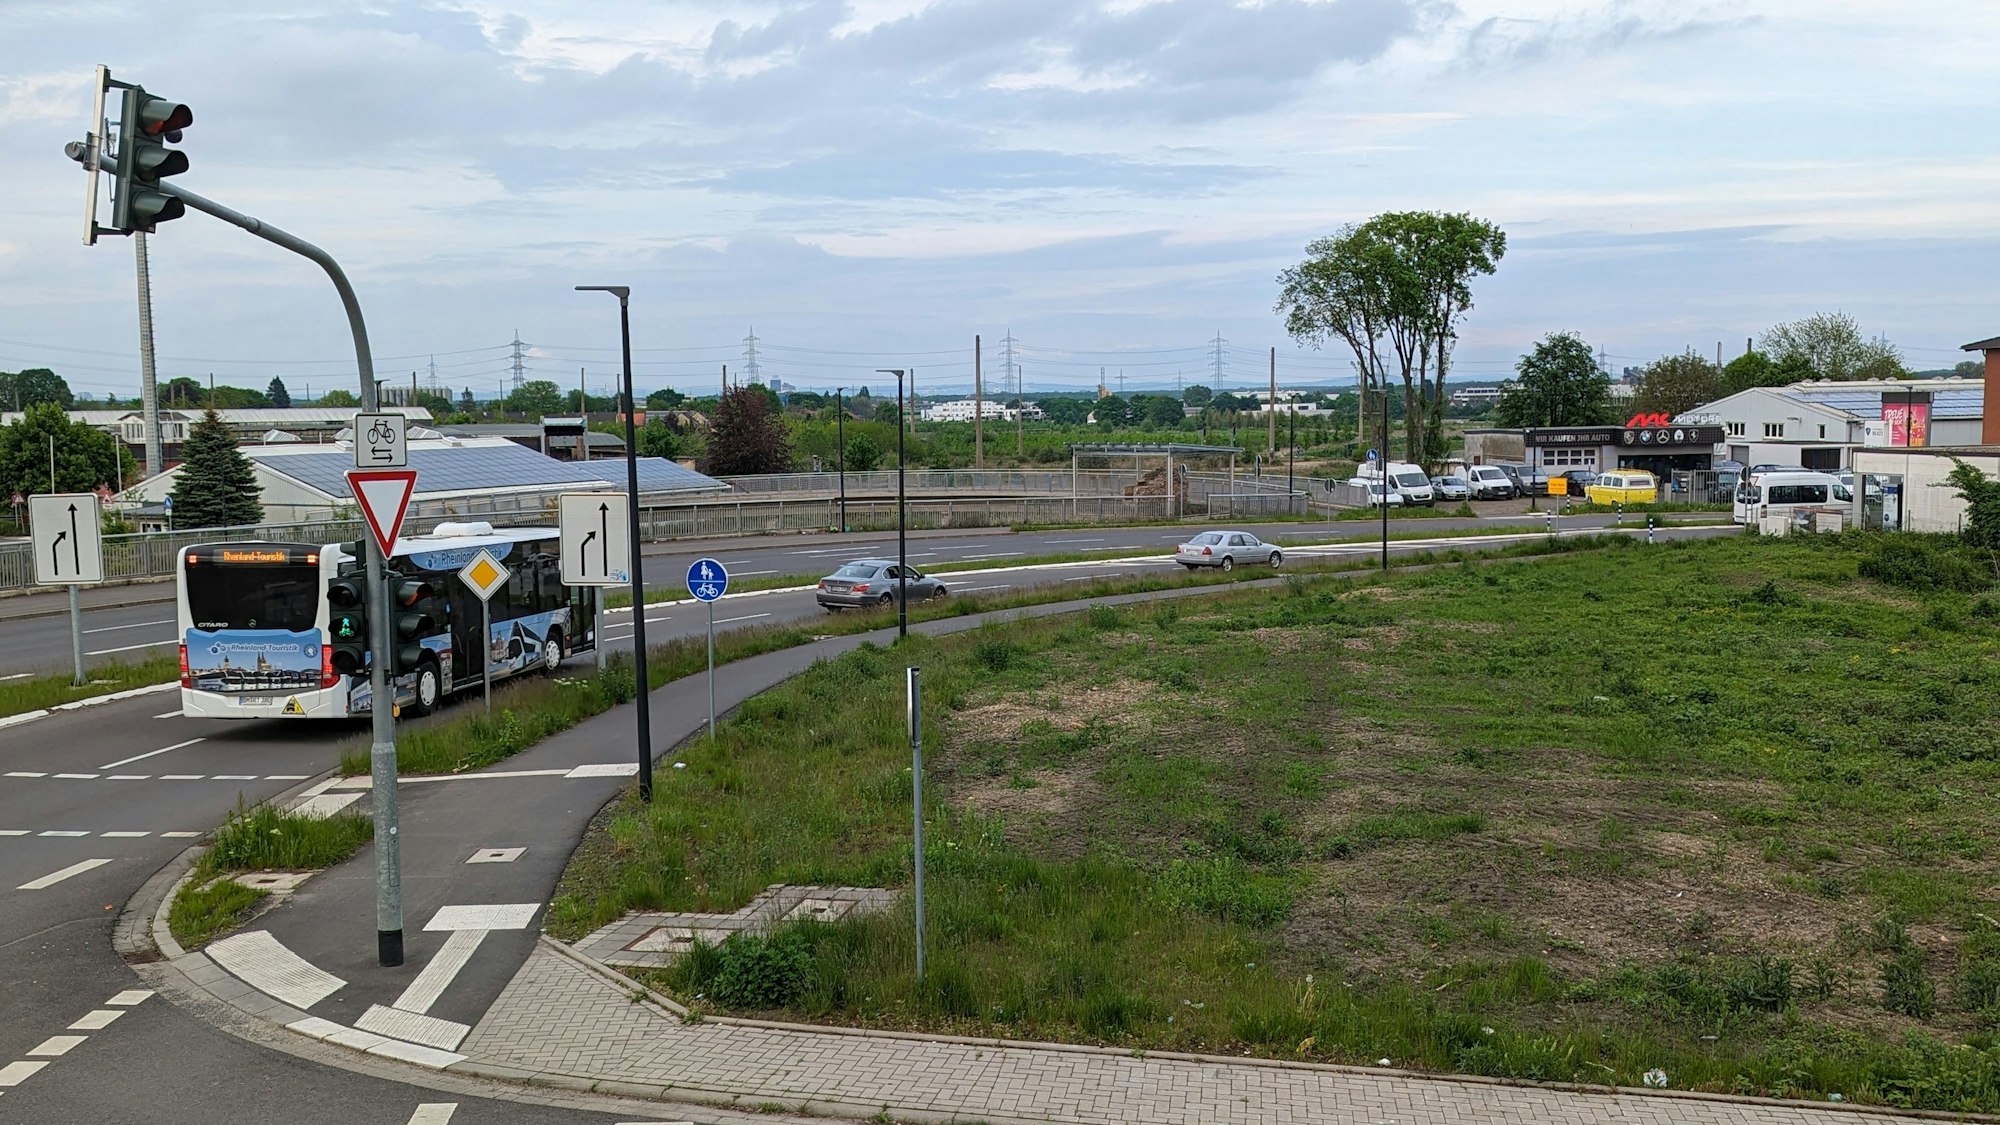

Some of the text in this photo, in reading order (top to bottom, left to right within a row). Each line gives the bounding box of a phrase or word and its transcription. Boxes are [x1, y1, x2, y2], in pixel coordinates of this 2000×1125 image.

[1672, 415, 1721, 423] MOTORS
[1549, 434, 1576, 442] KAUFEN
[1591, 433, 1610, 441] AUTO
[223, 552, 286, 561] Rheinland-Touristik
[231, 644, 299, 652] Rheinland-Touristik
